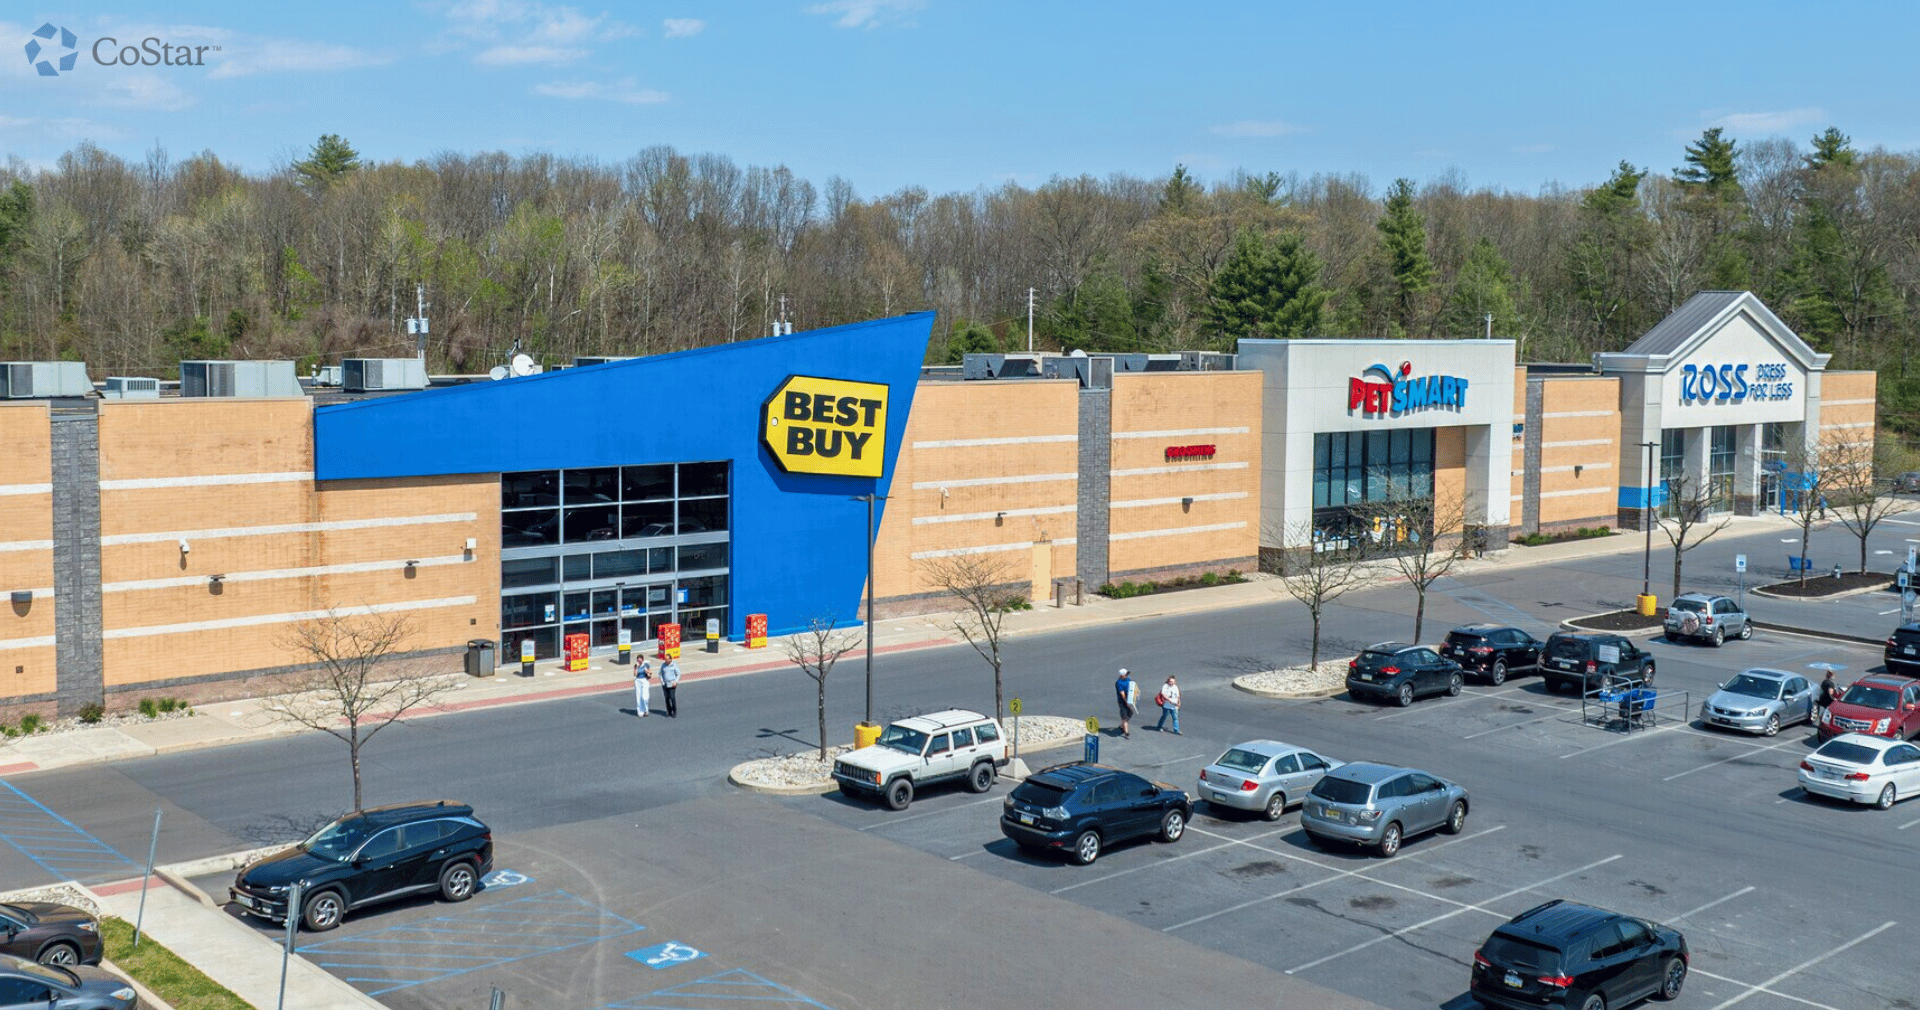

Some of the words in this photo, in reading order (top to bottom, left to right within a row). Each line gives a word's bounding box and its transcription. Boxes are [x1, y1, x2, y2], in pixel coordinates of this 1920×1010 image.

[1682, 364, 1748, 400] ROSS
[1757, 363, 1786, 379] DRESS
[1348, 374, 1469, 414] PETSMART
[1749, 383, 1768, 398] FOR
[1770, 382, 1792, 398] LESS
[784, 390, 882, 427] BEST
[786, 425, 873, 460] BUY
